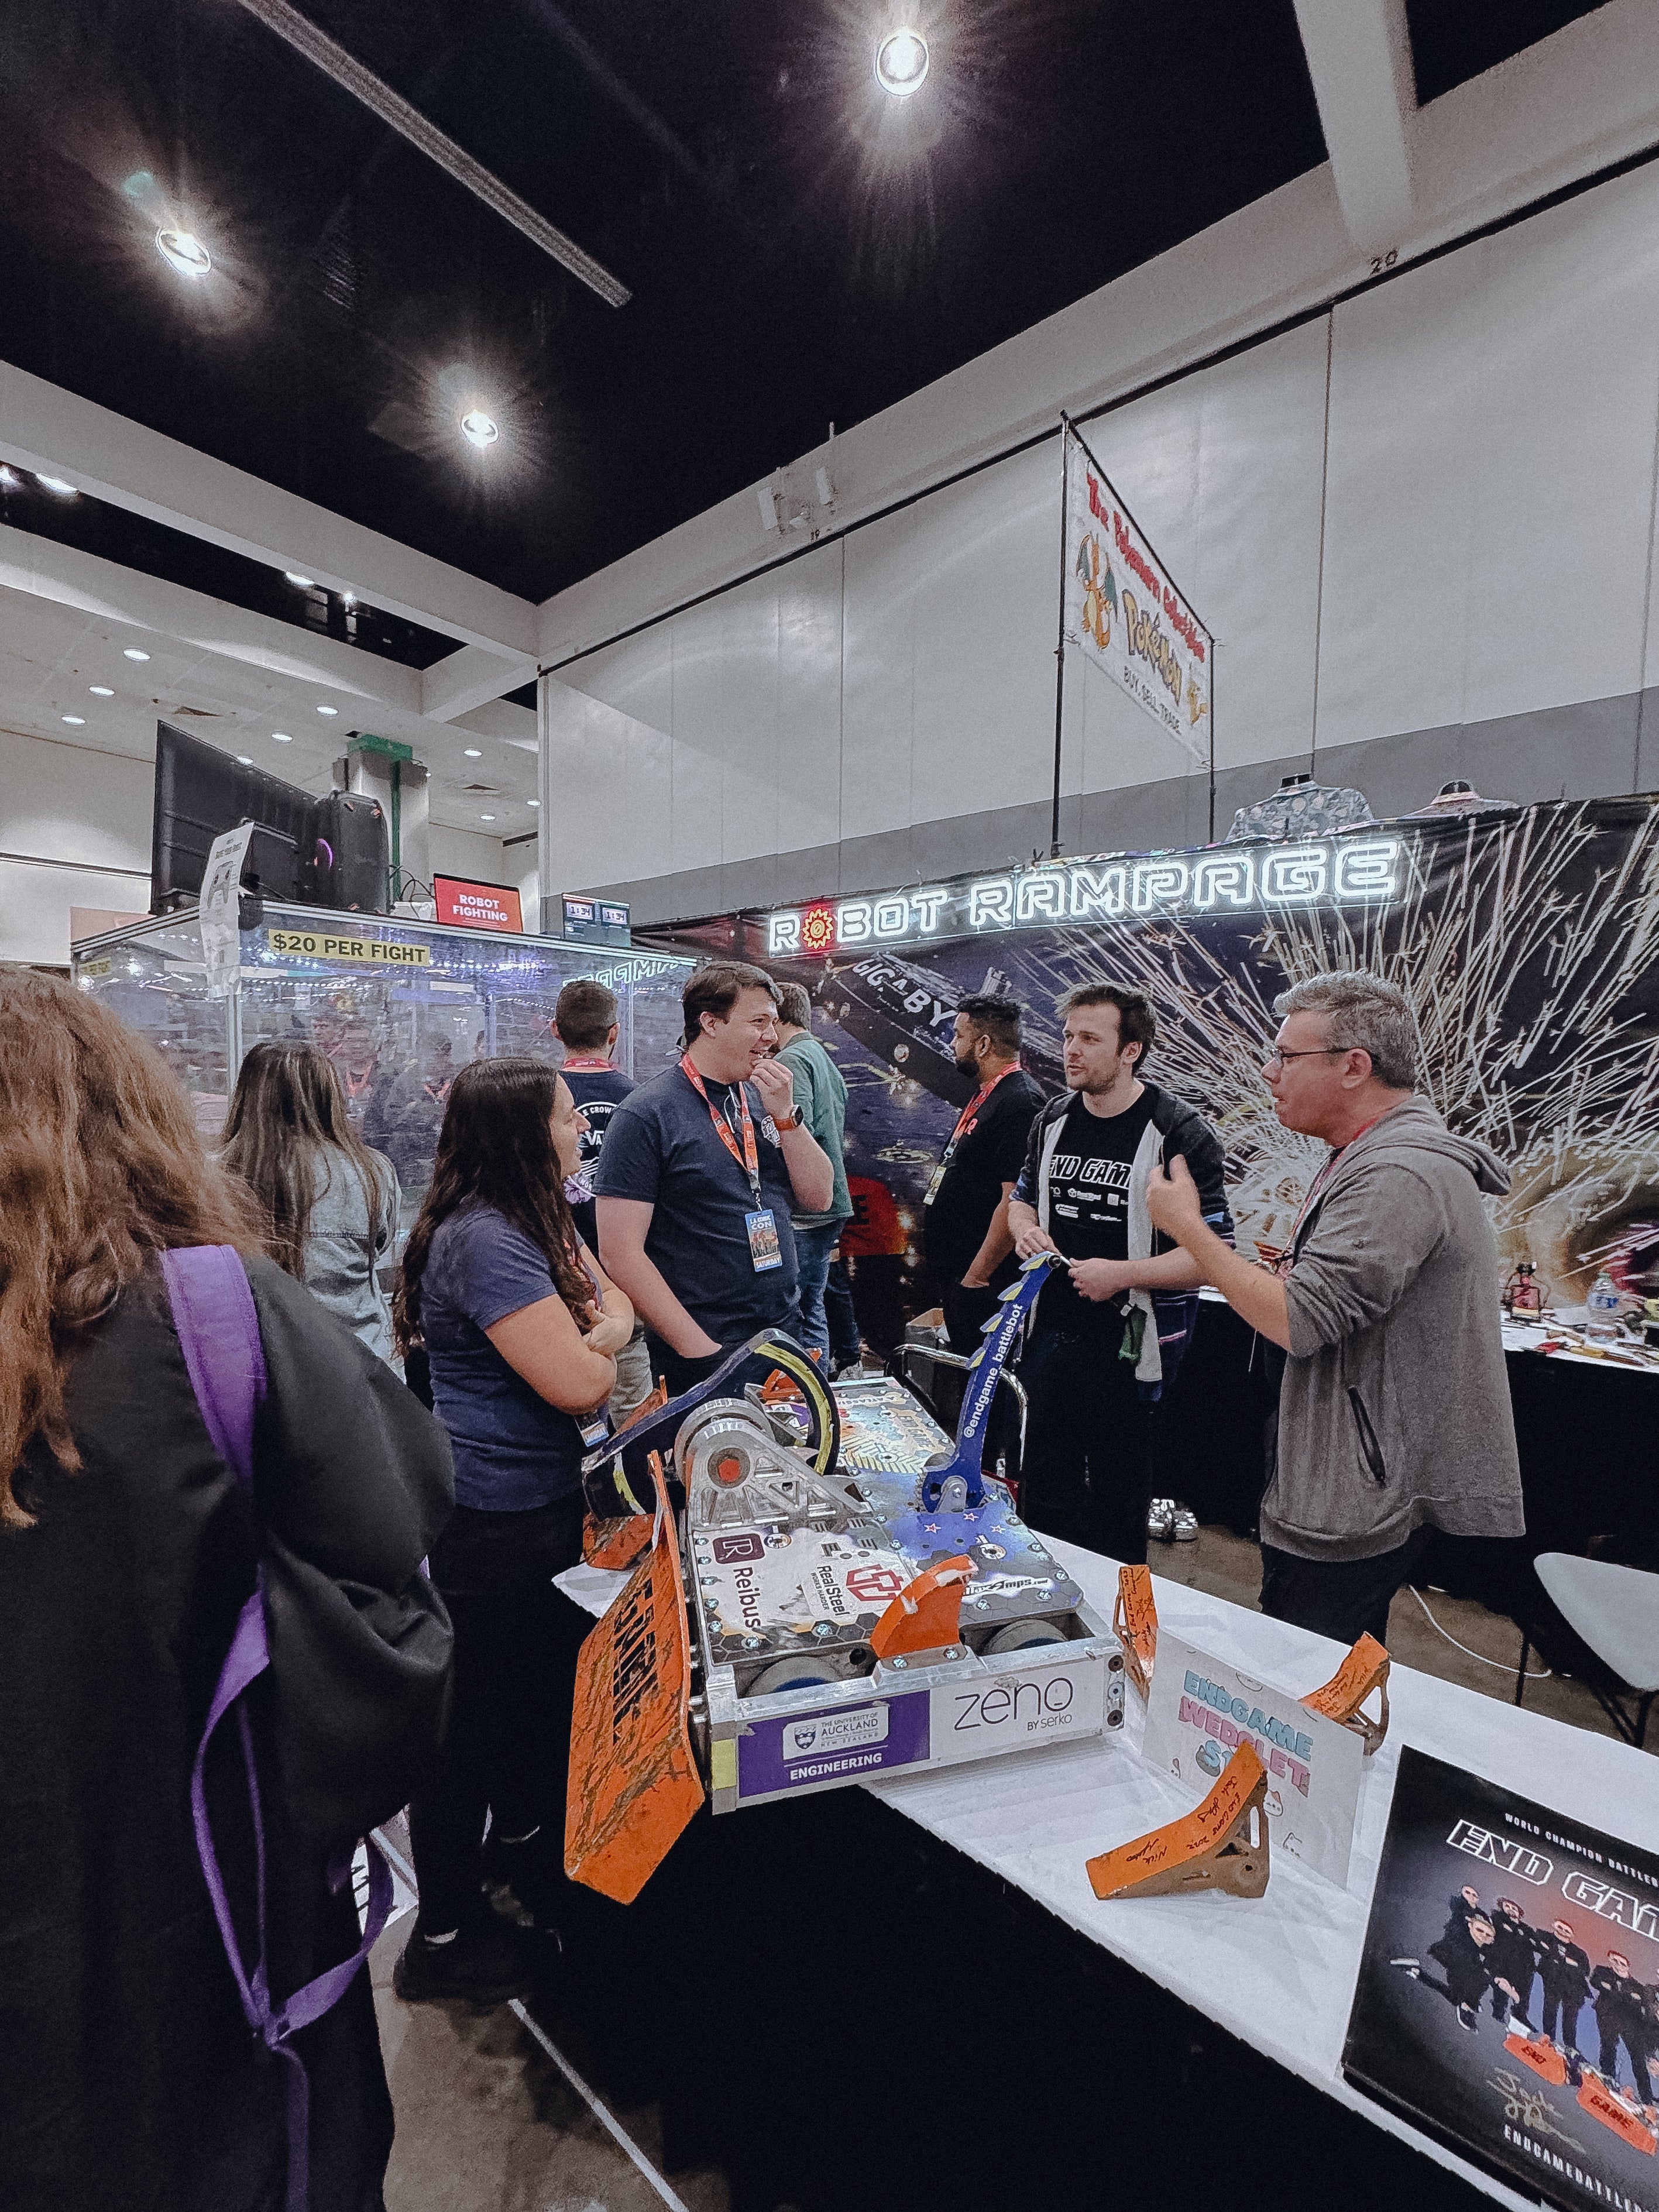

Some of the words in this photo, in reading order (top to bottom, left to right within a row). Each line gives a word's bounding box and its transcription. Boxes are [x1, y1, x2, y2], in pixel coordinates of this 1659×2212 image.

[1370, 249, 1398, 274] 20
[969, 840, 1400, 927] RAMPAGE
[452, 905, 508, 922] FIGHTING
[459, 894, 500, 909] ROBOT
[273, 933, 317, 953] $20
[324, 940, 363, 957] PER
[371, 943, 427, 963] FIGHT
[1080, 1158, 1132, 1190] GAM
[751, 1221, 772, 1230] CON
[963, 1303, 1023, 1438] @endgame_battlebot
[733, 1567, 761, 1628] Reibus
[954, 1677, 1073, 1730] zeno
[1184, 1670, 1313, 1761] ENDGAME
[821, 1718, 878, 1737] AUCKLAND
[834, 1713, 869, 1726] UNIVERSITY
[1027, 1720, 1039, 1731] BY
[1040, 1712, 1073, 1728] serko
[790, 1753, 882, 1781] ENGINEERING
[1445, 1819, 1554, 1885] END
[1505, 1813, 1540, 1835] WORLD
[1545, 1830, 1603, 1864] CHAMPION
[1608, 1857, 1659, 1888] BATTLEB
[1590, 2095, 1634, 2129] GAME
